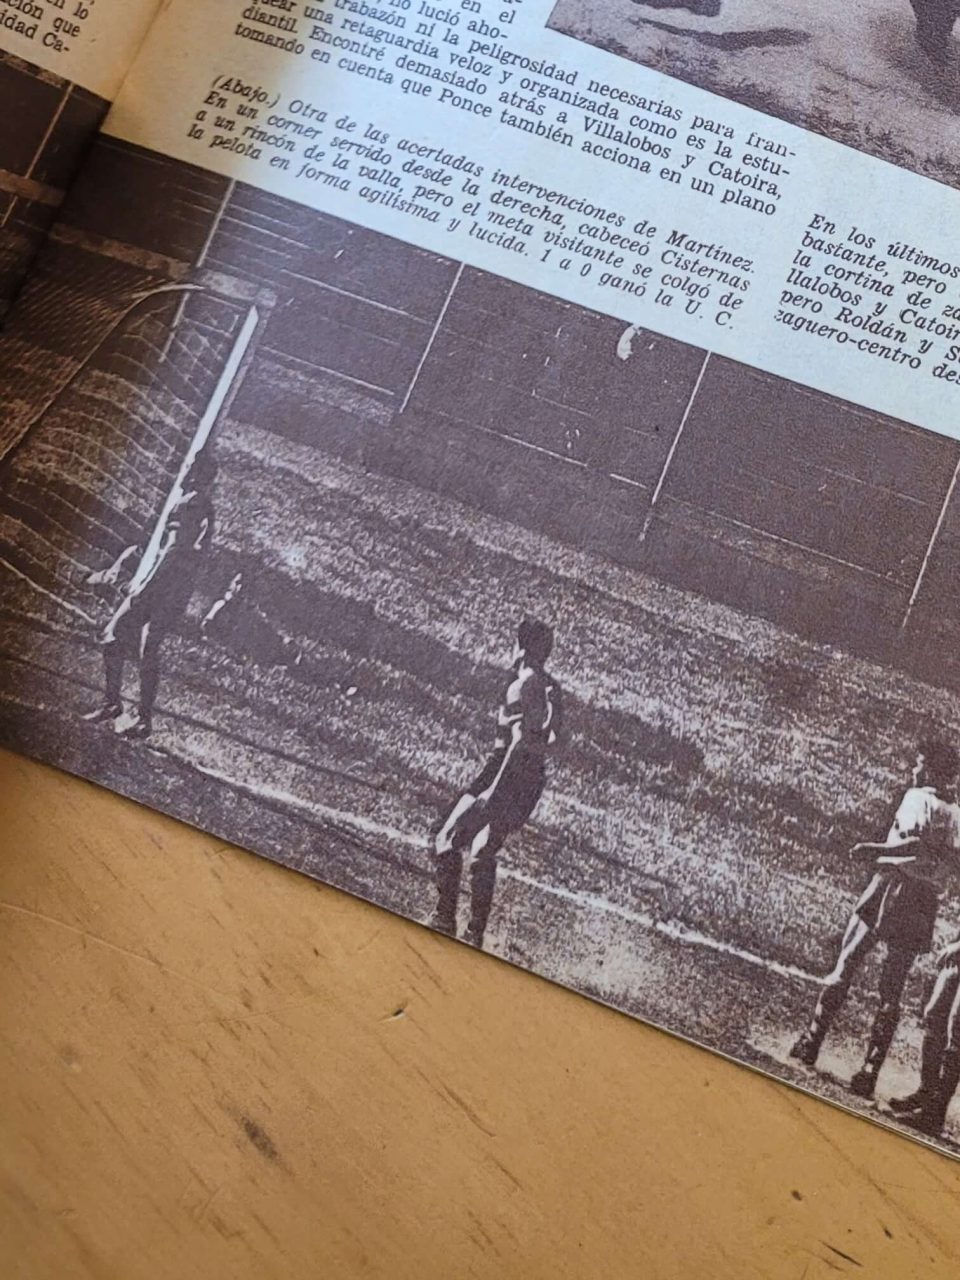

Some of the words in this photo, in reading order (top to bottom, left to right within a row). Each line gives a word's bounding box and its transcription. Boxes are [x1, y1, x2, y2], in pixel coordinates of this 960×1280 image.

[234, 23, 305, 55] tomando
[310, 48, 331, 64] en
[337, 57, 393, 85] cuenta
[400, 78, 432, 97] que
[437, 87, 492, 118] Ponce
[499, 108, 573, 147] también
[580, 140, 651, 174] acciona
[659, 167, 682, 184] en
[690, 176, 715, 196] un
[719, 188, 776, 216] plano
[414, 22, 436, 37] ni
[442, 27, 459, 46] la
[467, 39, 579, 86] peligrosidad
[586, 79, 683, 121] necesarias
[689, 115, 734, 139] para
[745, 131, 796, 157] fran-
[186, 123, 204, 140] la
[208, 134, 262, 160] pelota
[269, 156, 290, 171] en
[295, 162, 351, 191] forma
[358, 186, 440, 223] agilísima
[446, 217, 461, 232] y
[468, 221, 528, 256] lucida.
[539, 248, 552, 263] 1
[558, 258, 572, 271] a
[579, 262, 592, 277] 0
[597, 272, 647, 297] ganó
[654, 288, 674, 307] la
[684, 298, 703, 319] U.
[714, 310, 733, 330] C.
[194, 109, 207, 122] a
[213, 115, 235, 131] un
[241, 125, 295, 152] rincón
[303, 144, 325, 162] de
[331, 153, 350, 170] la
[357, 165, 403, 193] valla,
[411, 185, 454, 207] pero
[461, 201, 481, 217] el
[487, 211, 534, 236] meta
[543, 230, 624, 268] visitante
[632, 263, 653, 279] se
[660, 273, 711, 299] colgó
[718, 292, 744, 310] de
[203, 90, 228, 109] En
[236, 104, 258, 119] un
[266, 114, 323, 139] corner
[329, 136, 392, 165] servido
[401, 159, 453, 186] desde
[461, 177, 480, 196] la
[489, 189, 566, 230] derecha,
[578, 223, 650, 256] cabeceó
[660, 249, 751, 292] Cisternas
[211, 75, 281, 109] (Abajo.)
[288, 99, 328, 123] Otra
[334, 115, 357, 132] de
[363, 122, 390, 144] las
[396, 138, 484, 177] acertadas
[491, 168, 626, 227] intervenciones
[633, 219, 657, 238] de
[665, 229, 754, 273] Martínez.
[785, 267, 862, 306] llalobos
[871, 301, 888, 317] y
[792, 248, 812, 268] la
[823, 263, 895, 297] cortina
[906, 291, 932, 309] de
[801, 230, 889, 277] bastante,
[900, 270, 947, 294] pero
[807, 213, 836, 235] En
[846, 226, 876, 249] los
[886, 241, 960, 278] últimos
[779, 289, 823, 313] pero
[834, 306, 907, 343] Roldán
[917, 338, 934, 354] y
